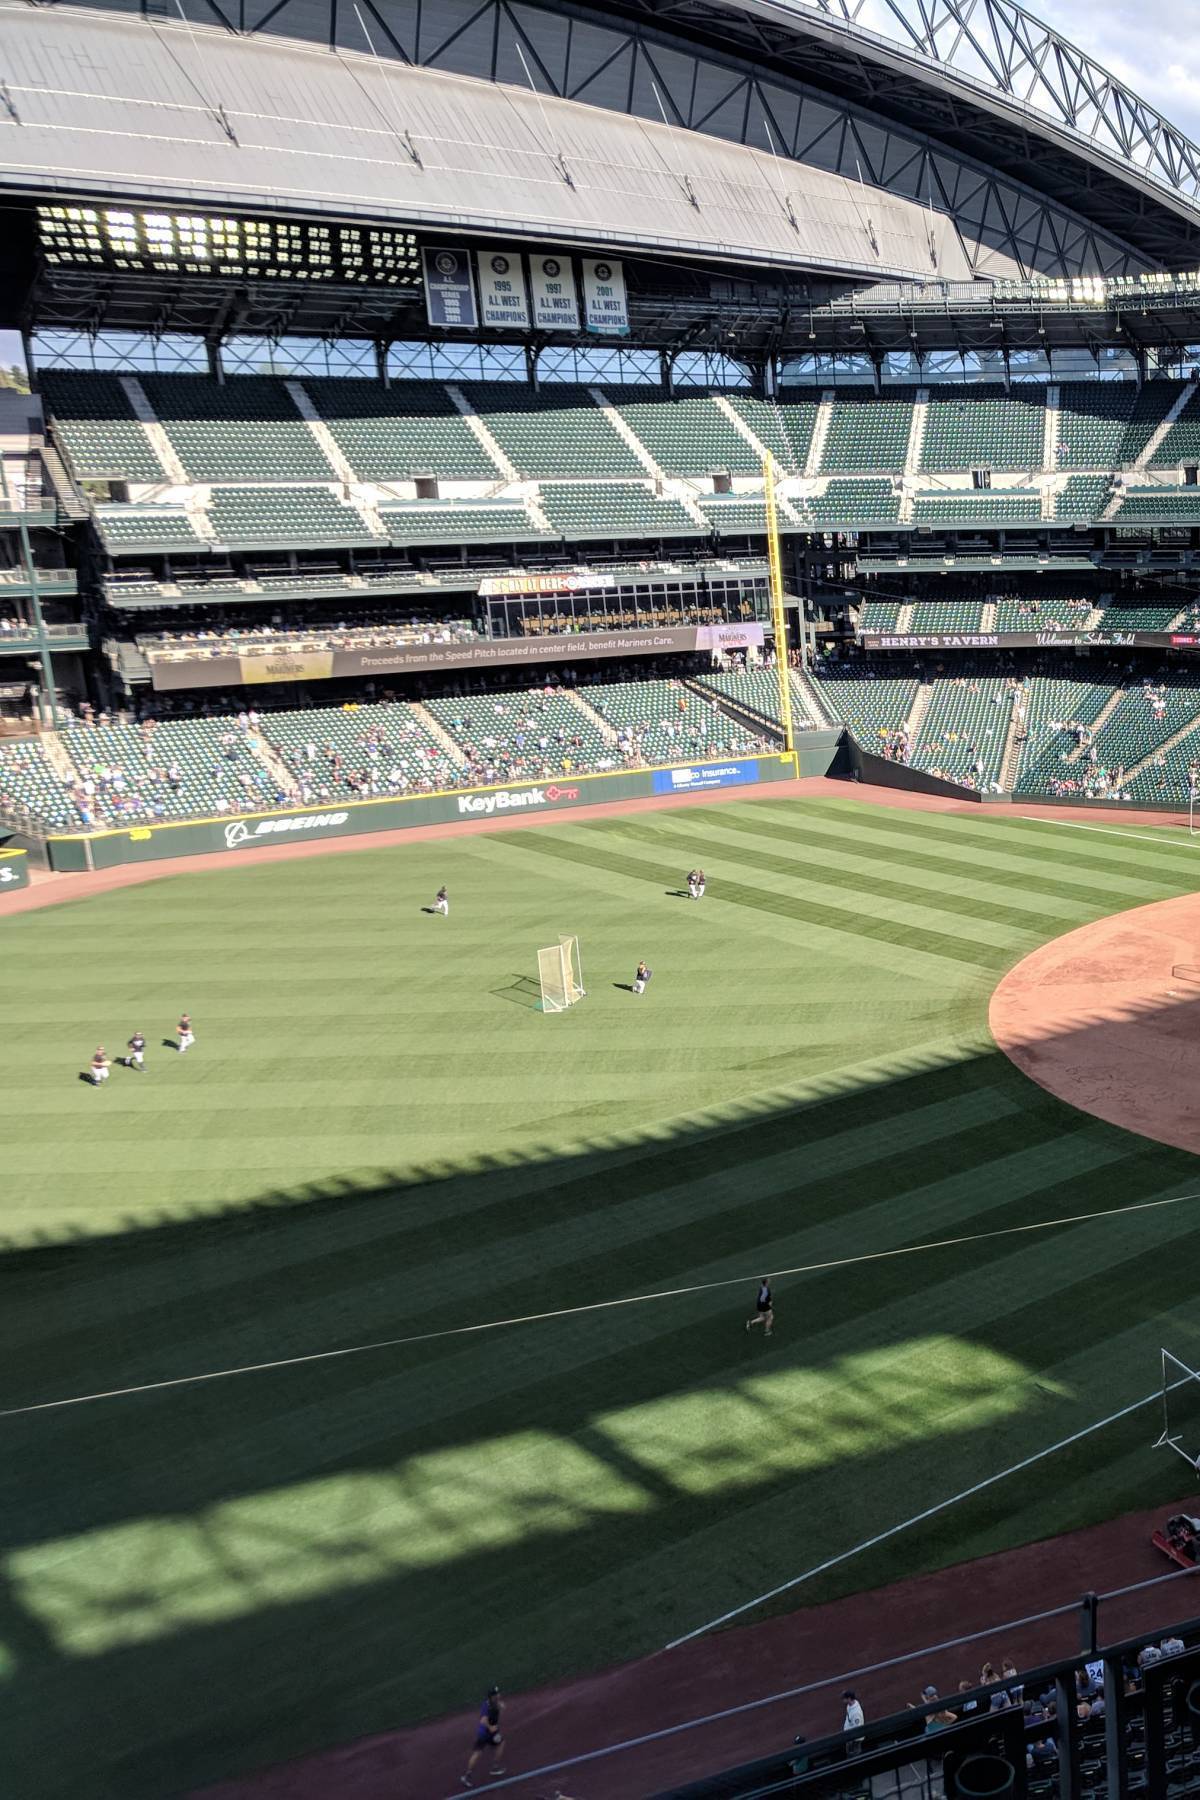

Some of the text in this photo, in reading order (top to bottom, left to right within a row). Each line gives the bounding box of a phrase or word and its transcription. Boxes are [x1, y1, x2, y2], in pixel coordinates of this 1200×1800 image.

[494, 281, 511, 292] 1995
[546, 283, 561, 294] 1997
[596, 286, 613, 297] 2001
[501, 295, 520, 307] WEST
[553, 298, 571, 309] WEST
[603, 300, 620, 311] WEST
[485, 310, 526, 322] CHAMPIONS
[537, 313, 577, 324] CHAMPIONS
[589, 314, 625, 325] CHAMPIONS
[881, 637, 939, 647] HENRY'S
[943, 636, 998, 646] TAVERN
[1036, 633, 1135, 646] Welcome to Safeco Field
[360, 636, 674, 666] Proceeds from the Speed Pitch located in center field, benefit Mariners Care.
[458, 787, 547, 813] KeyBank
[254, 812, 349, 833] BOEING
[1089, 1668, 1103, 1680] 24
